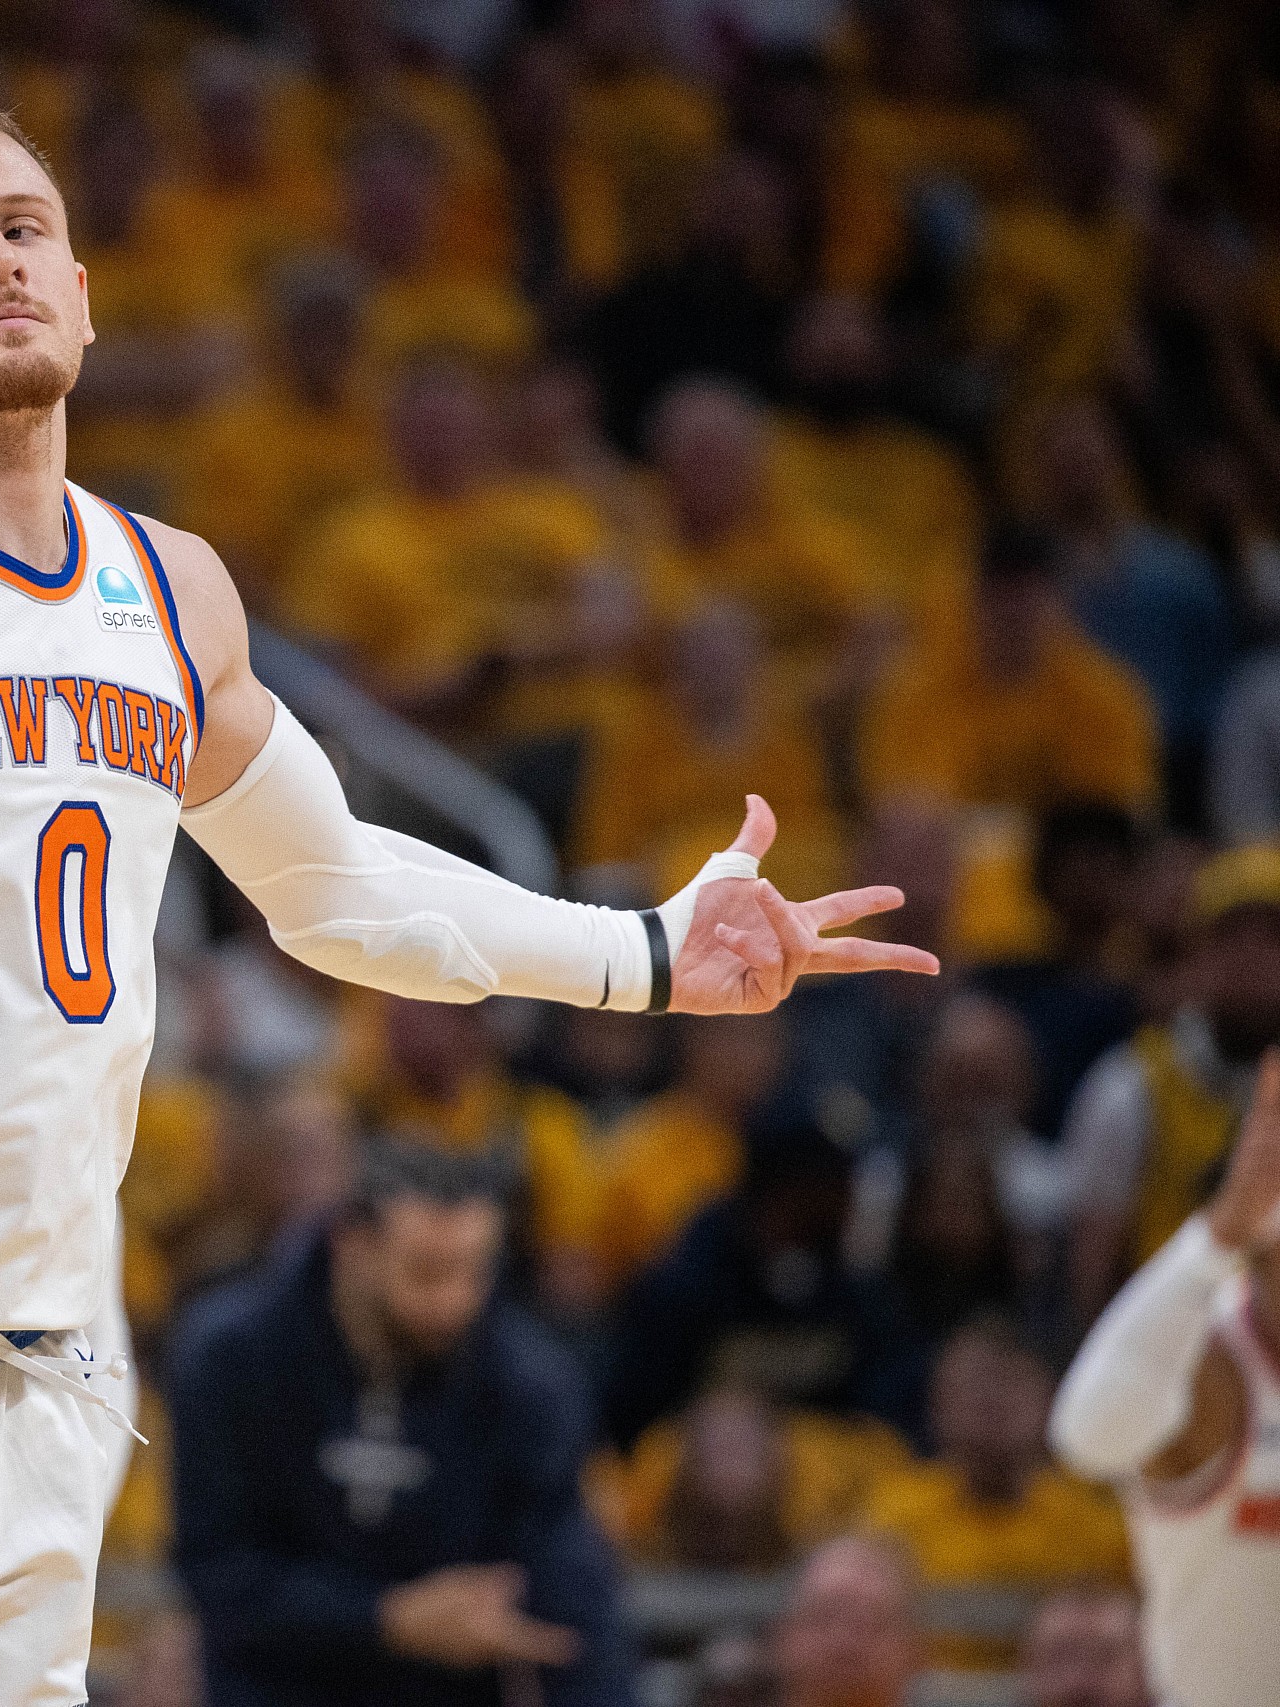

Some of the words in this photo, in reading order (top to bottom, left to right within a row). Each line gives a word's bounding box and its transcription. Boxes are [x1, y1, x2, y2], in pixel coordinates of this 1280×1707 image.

[102, 609, 156, 630] sphere
[51, 676, 188, 803] YORK
[35, 800, 117, 1025] 0
